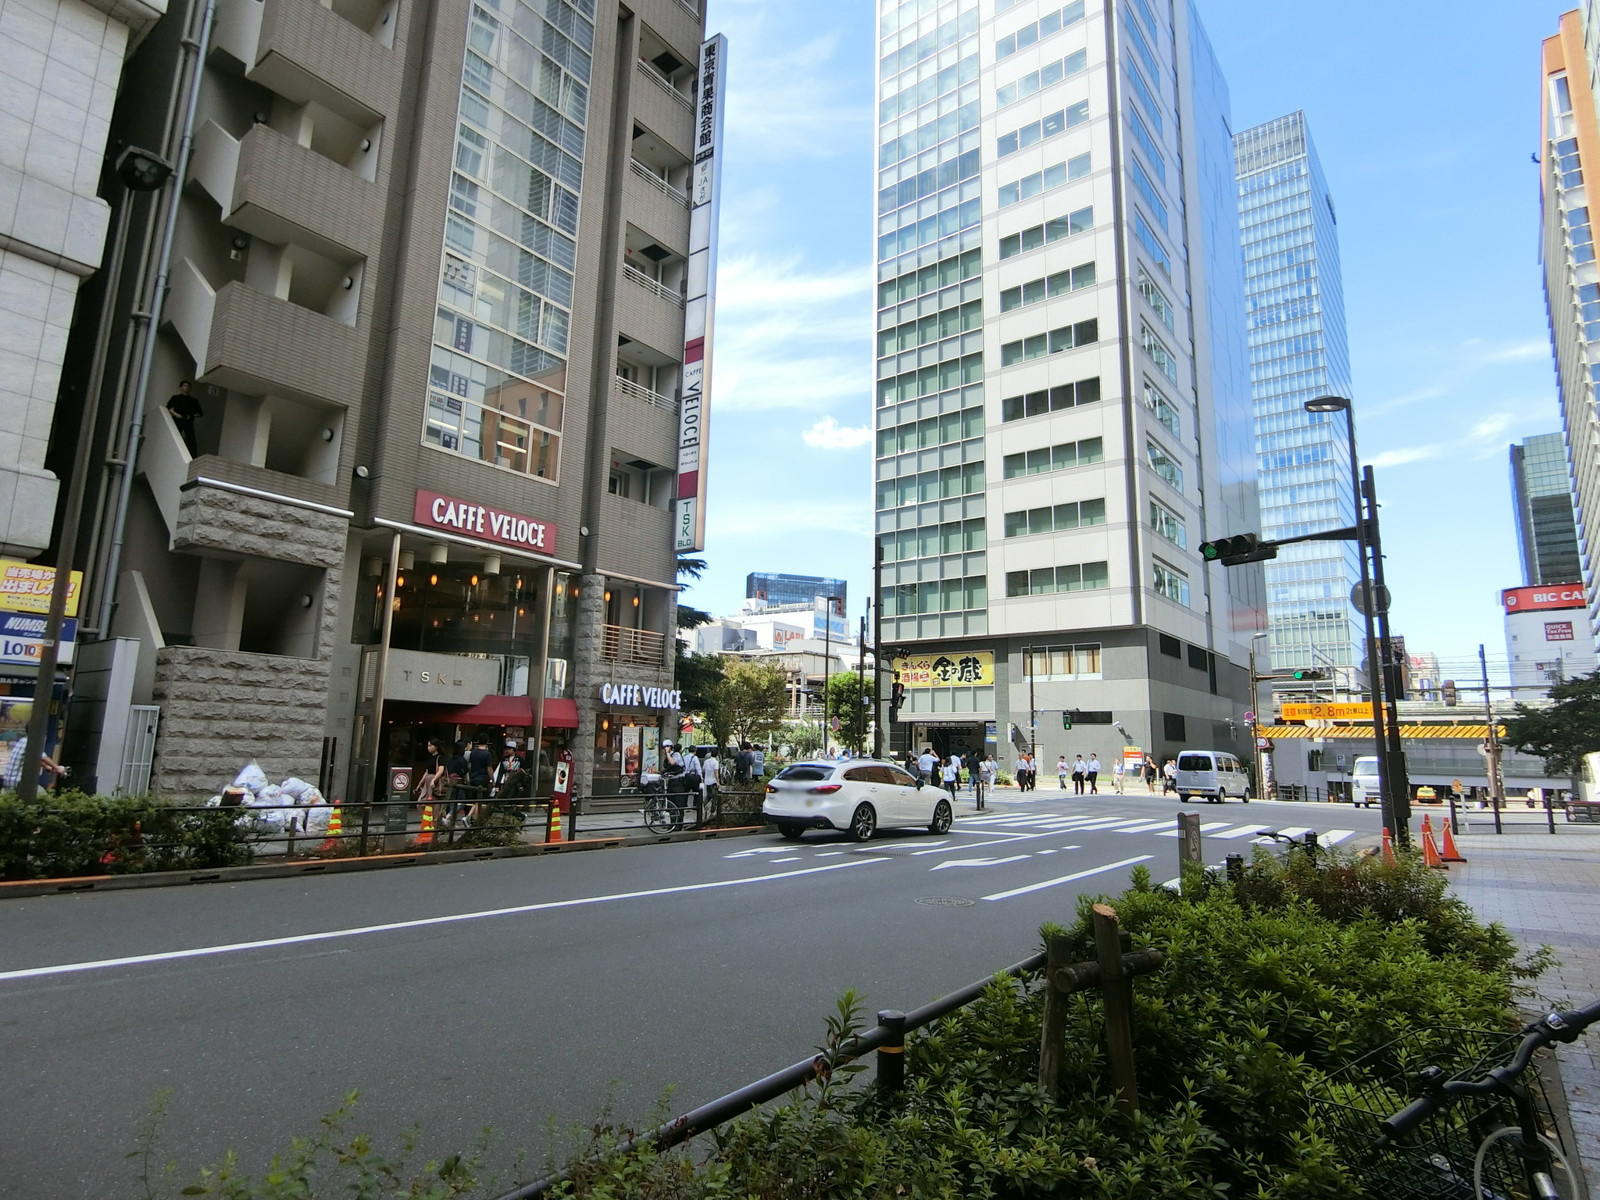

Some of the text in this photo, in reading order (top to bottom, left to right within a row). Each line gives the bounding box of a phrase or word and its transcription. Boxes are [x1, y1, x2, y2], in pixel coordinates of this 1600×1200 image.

[699, 43, 717, 147] 東京青果商会館
[683, 380, 700, 445] VELOCE
[489, 511, 546, 547] VELOCE
[6, 567, 56, 579] 当売場か
[1533, 593, 1557, 603] BIC
[932, 656, 982, 682] 金の蔵
[641, 686, 682, 710] VELOCE
[1314, 706, 1345, 717] 2.8m
